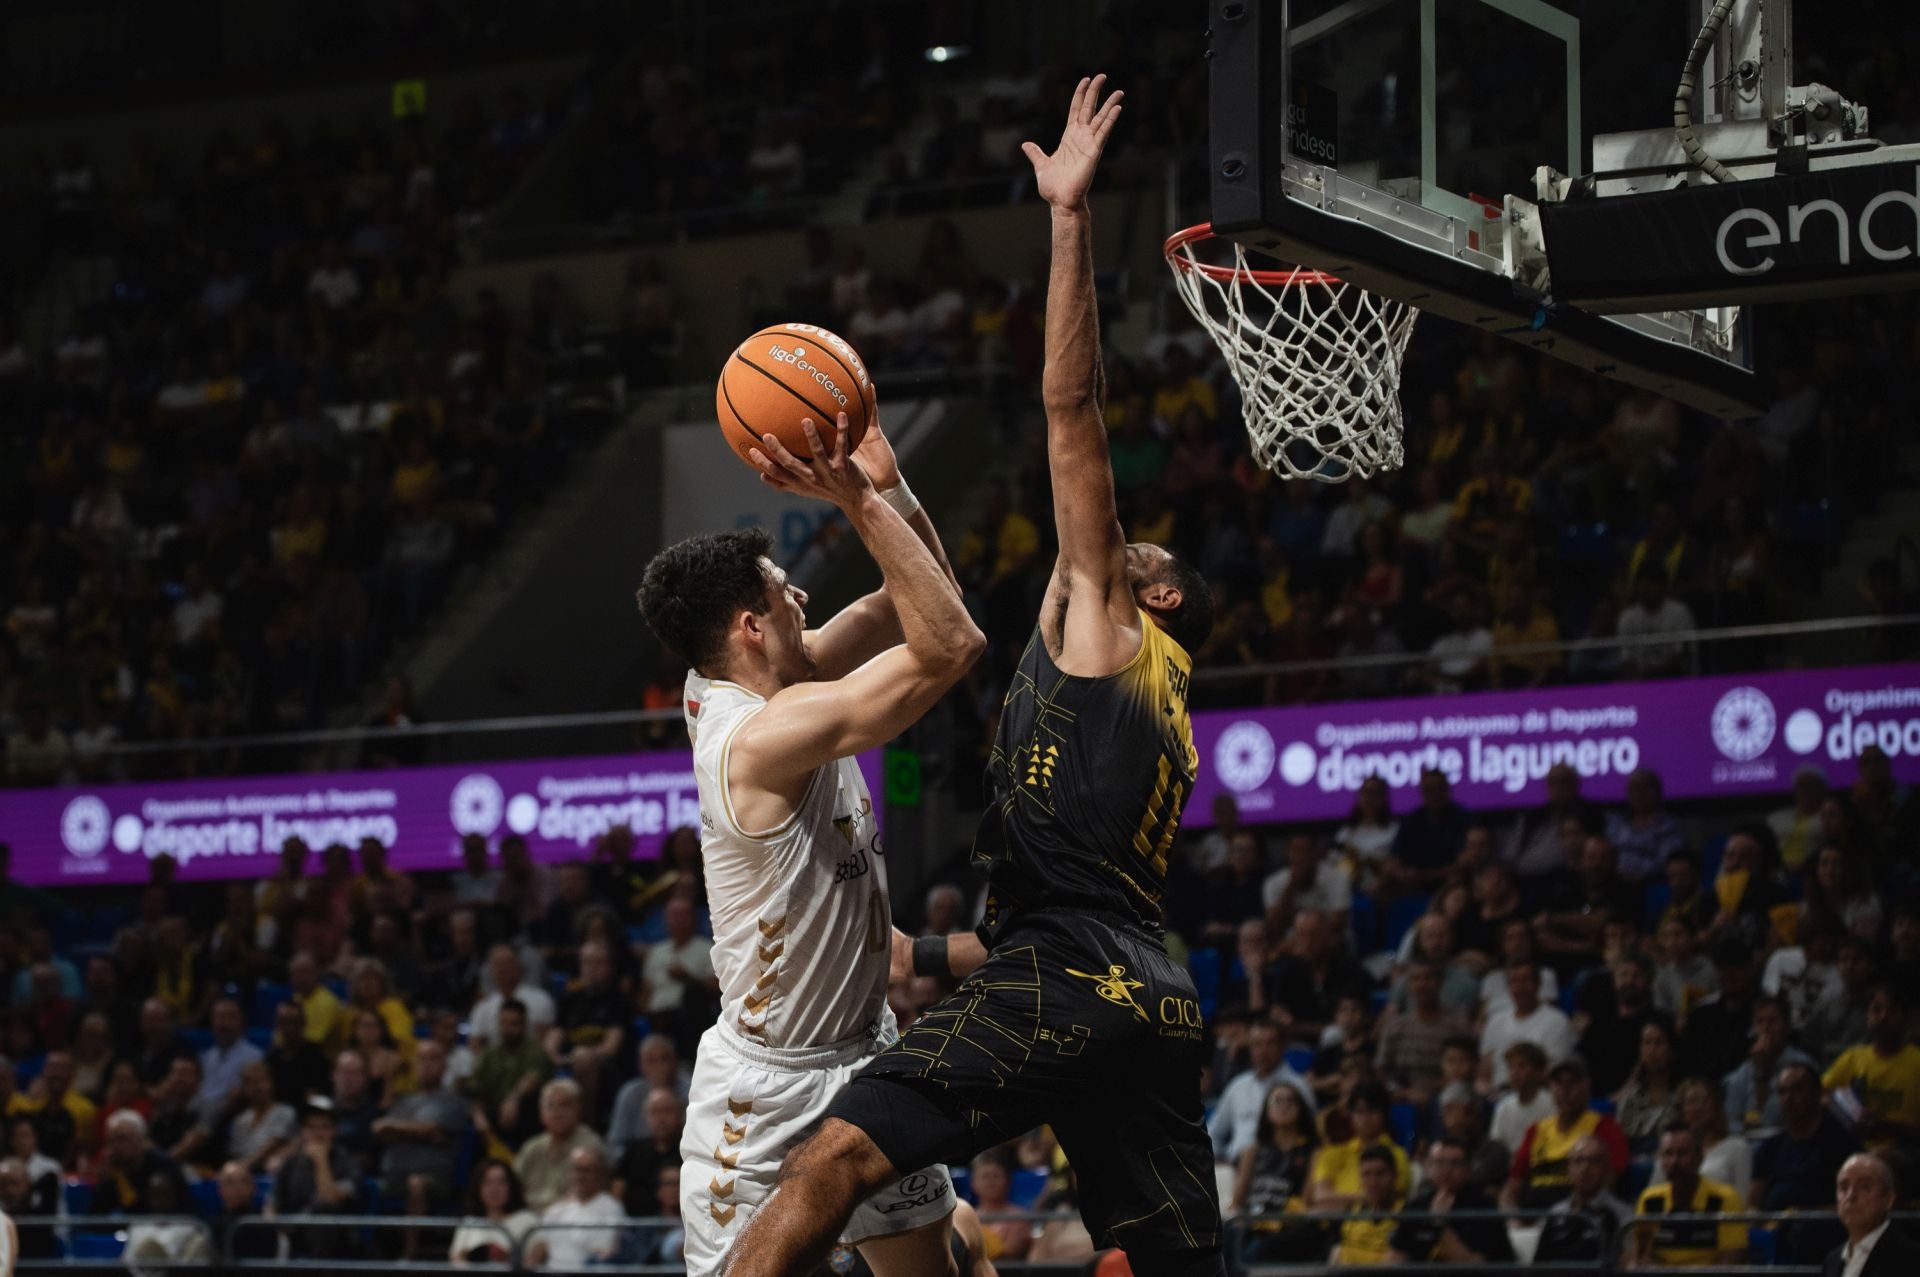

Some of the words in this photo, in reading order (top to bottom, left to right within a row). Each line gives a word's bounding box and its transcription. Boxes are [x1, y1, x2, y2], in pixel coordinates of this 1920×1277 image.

[768, 344, 797, 365] liga
[797, 359, 848, 407] endesa
[1316, 719, 1418, 750] Organismo
[1522, 708, 1548, 734] de
[1551, 705, 1638, 735] Deportes
[1469, 735, 1640, 793] lagunero
[874, 1178, 949, 1215] LEXUS
